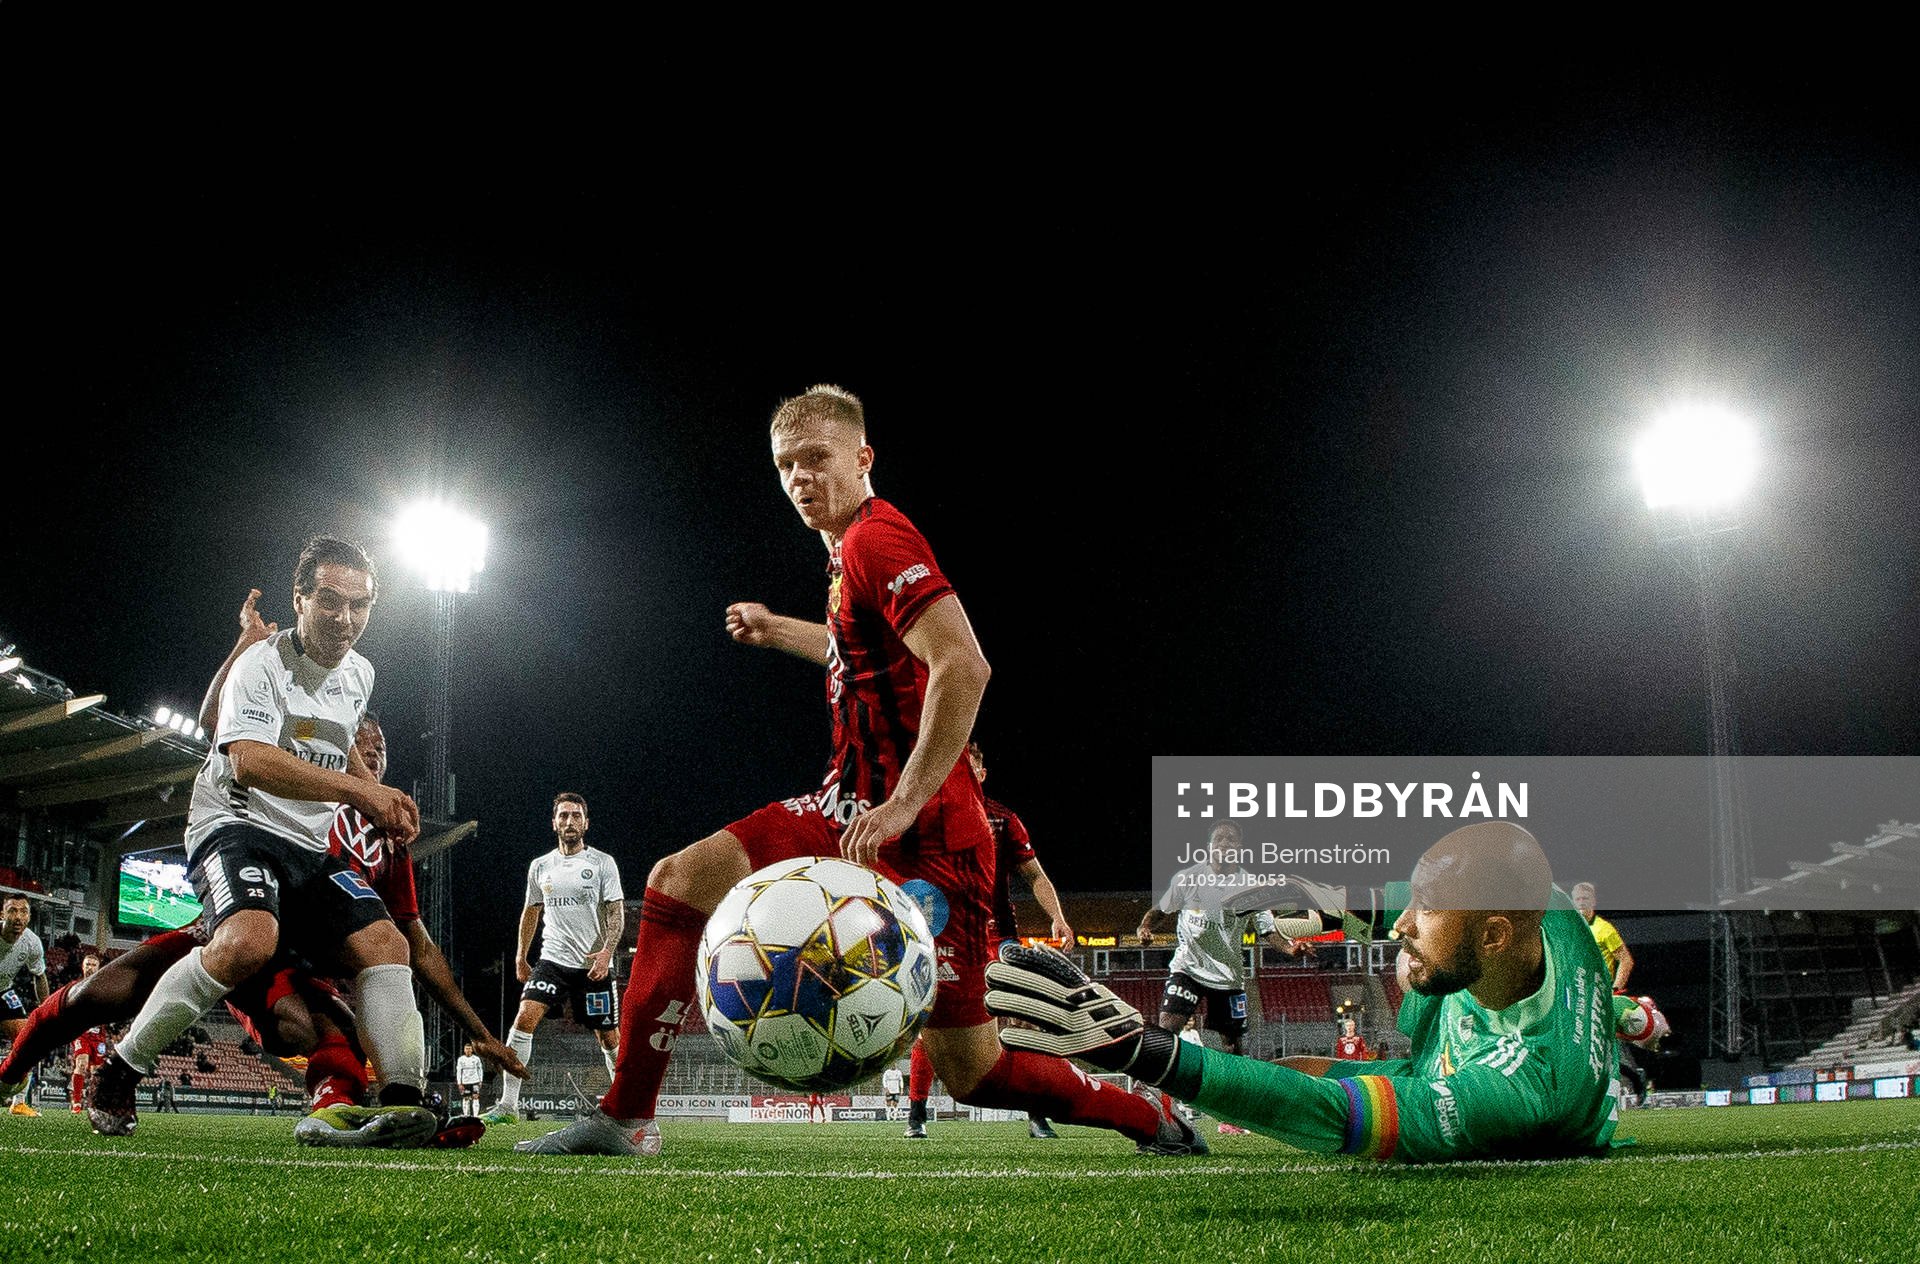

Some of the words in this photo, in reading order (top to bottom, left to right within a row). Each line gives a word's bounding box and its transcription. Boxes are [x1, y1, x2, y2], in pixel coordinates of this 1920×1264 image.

[242, 708, 274, 724] UNIBET
[247, 888, 265, 898] 25
[845, 1013, 866, 1046] SELECT
[516, 1097, 576, 1110] eklam.se
[656, 1100, 683, 1108] ICON
[688, 1100, 716, 1108] ICON
[721, 1100, 749, 1108] ICON
